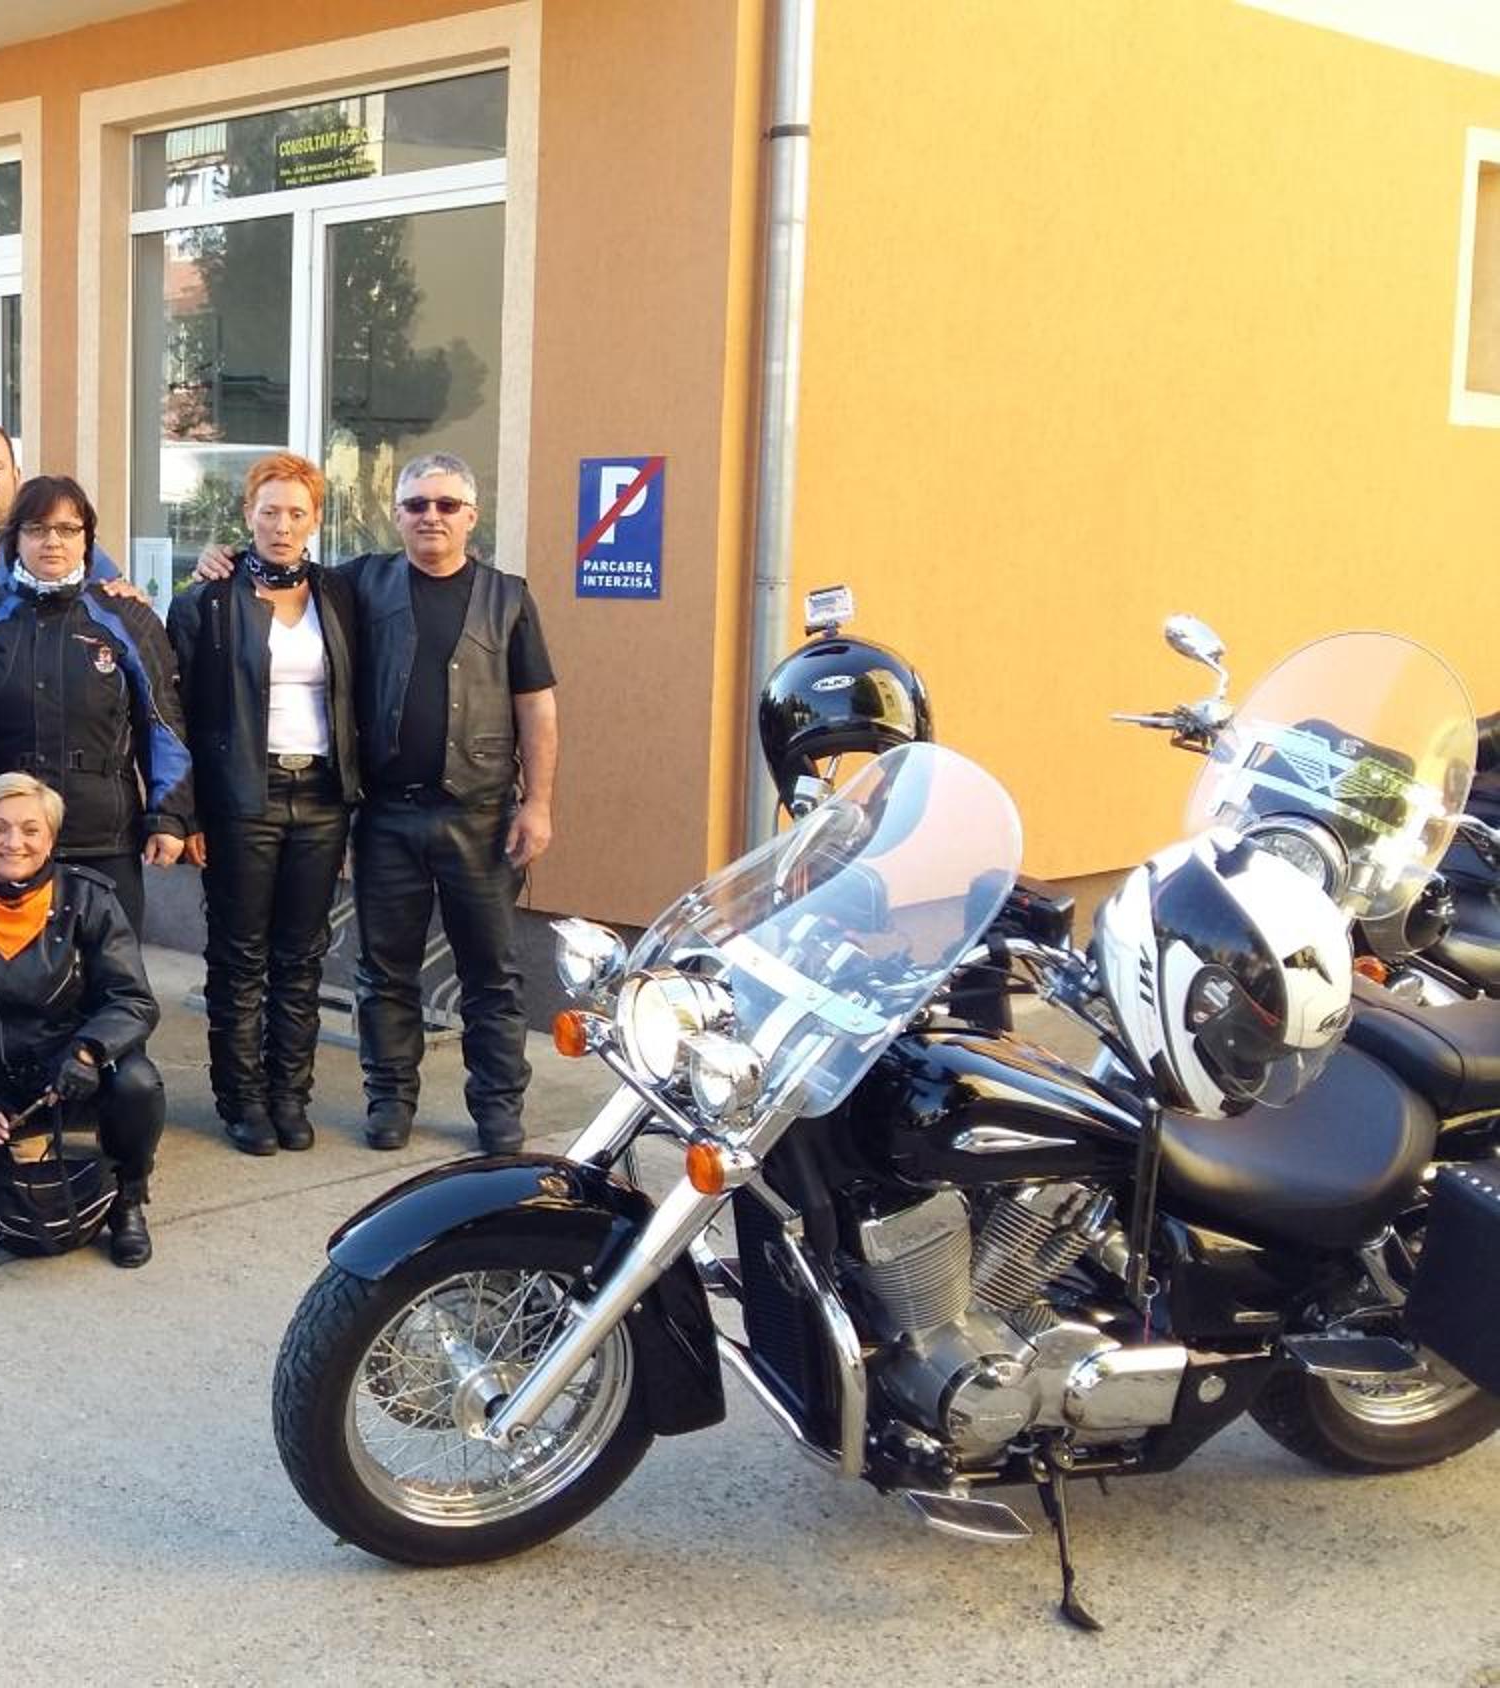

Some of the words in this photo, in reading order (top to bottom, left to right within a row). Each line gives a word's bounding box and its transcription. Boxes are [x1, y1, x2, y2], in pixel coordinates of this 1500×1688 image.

[279, 131, 338, 157] CONSULTANT
[598, 465, 648, 544] P
[583, 559, 653, 574] PARCAREA
